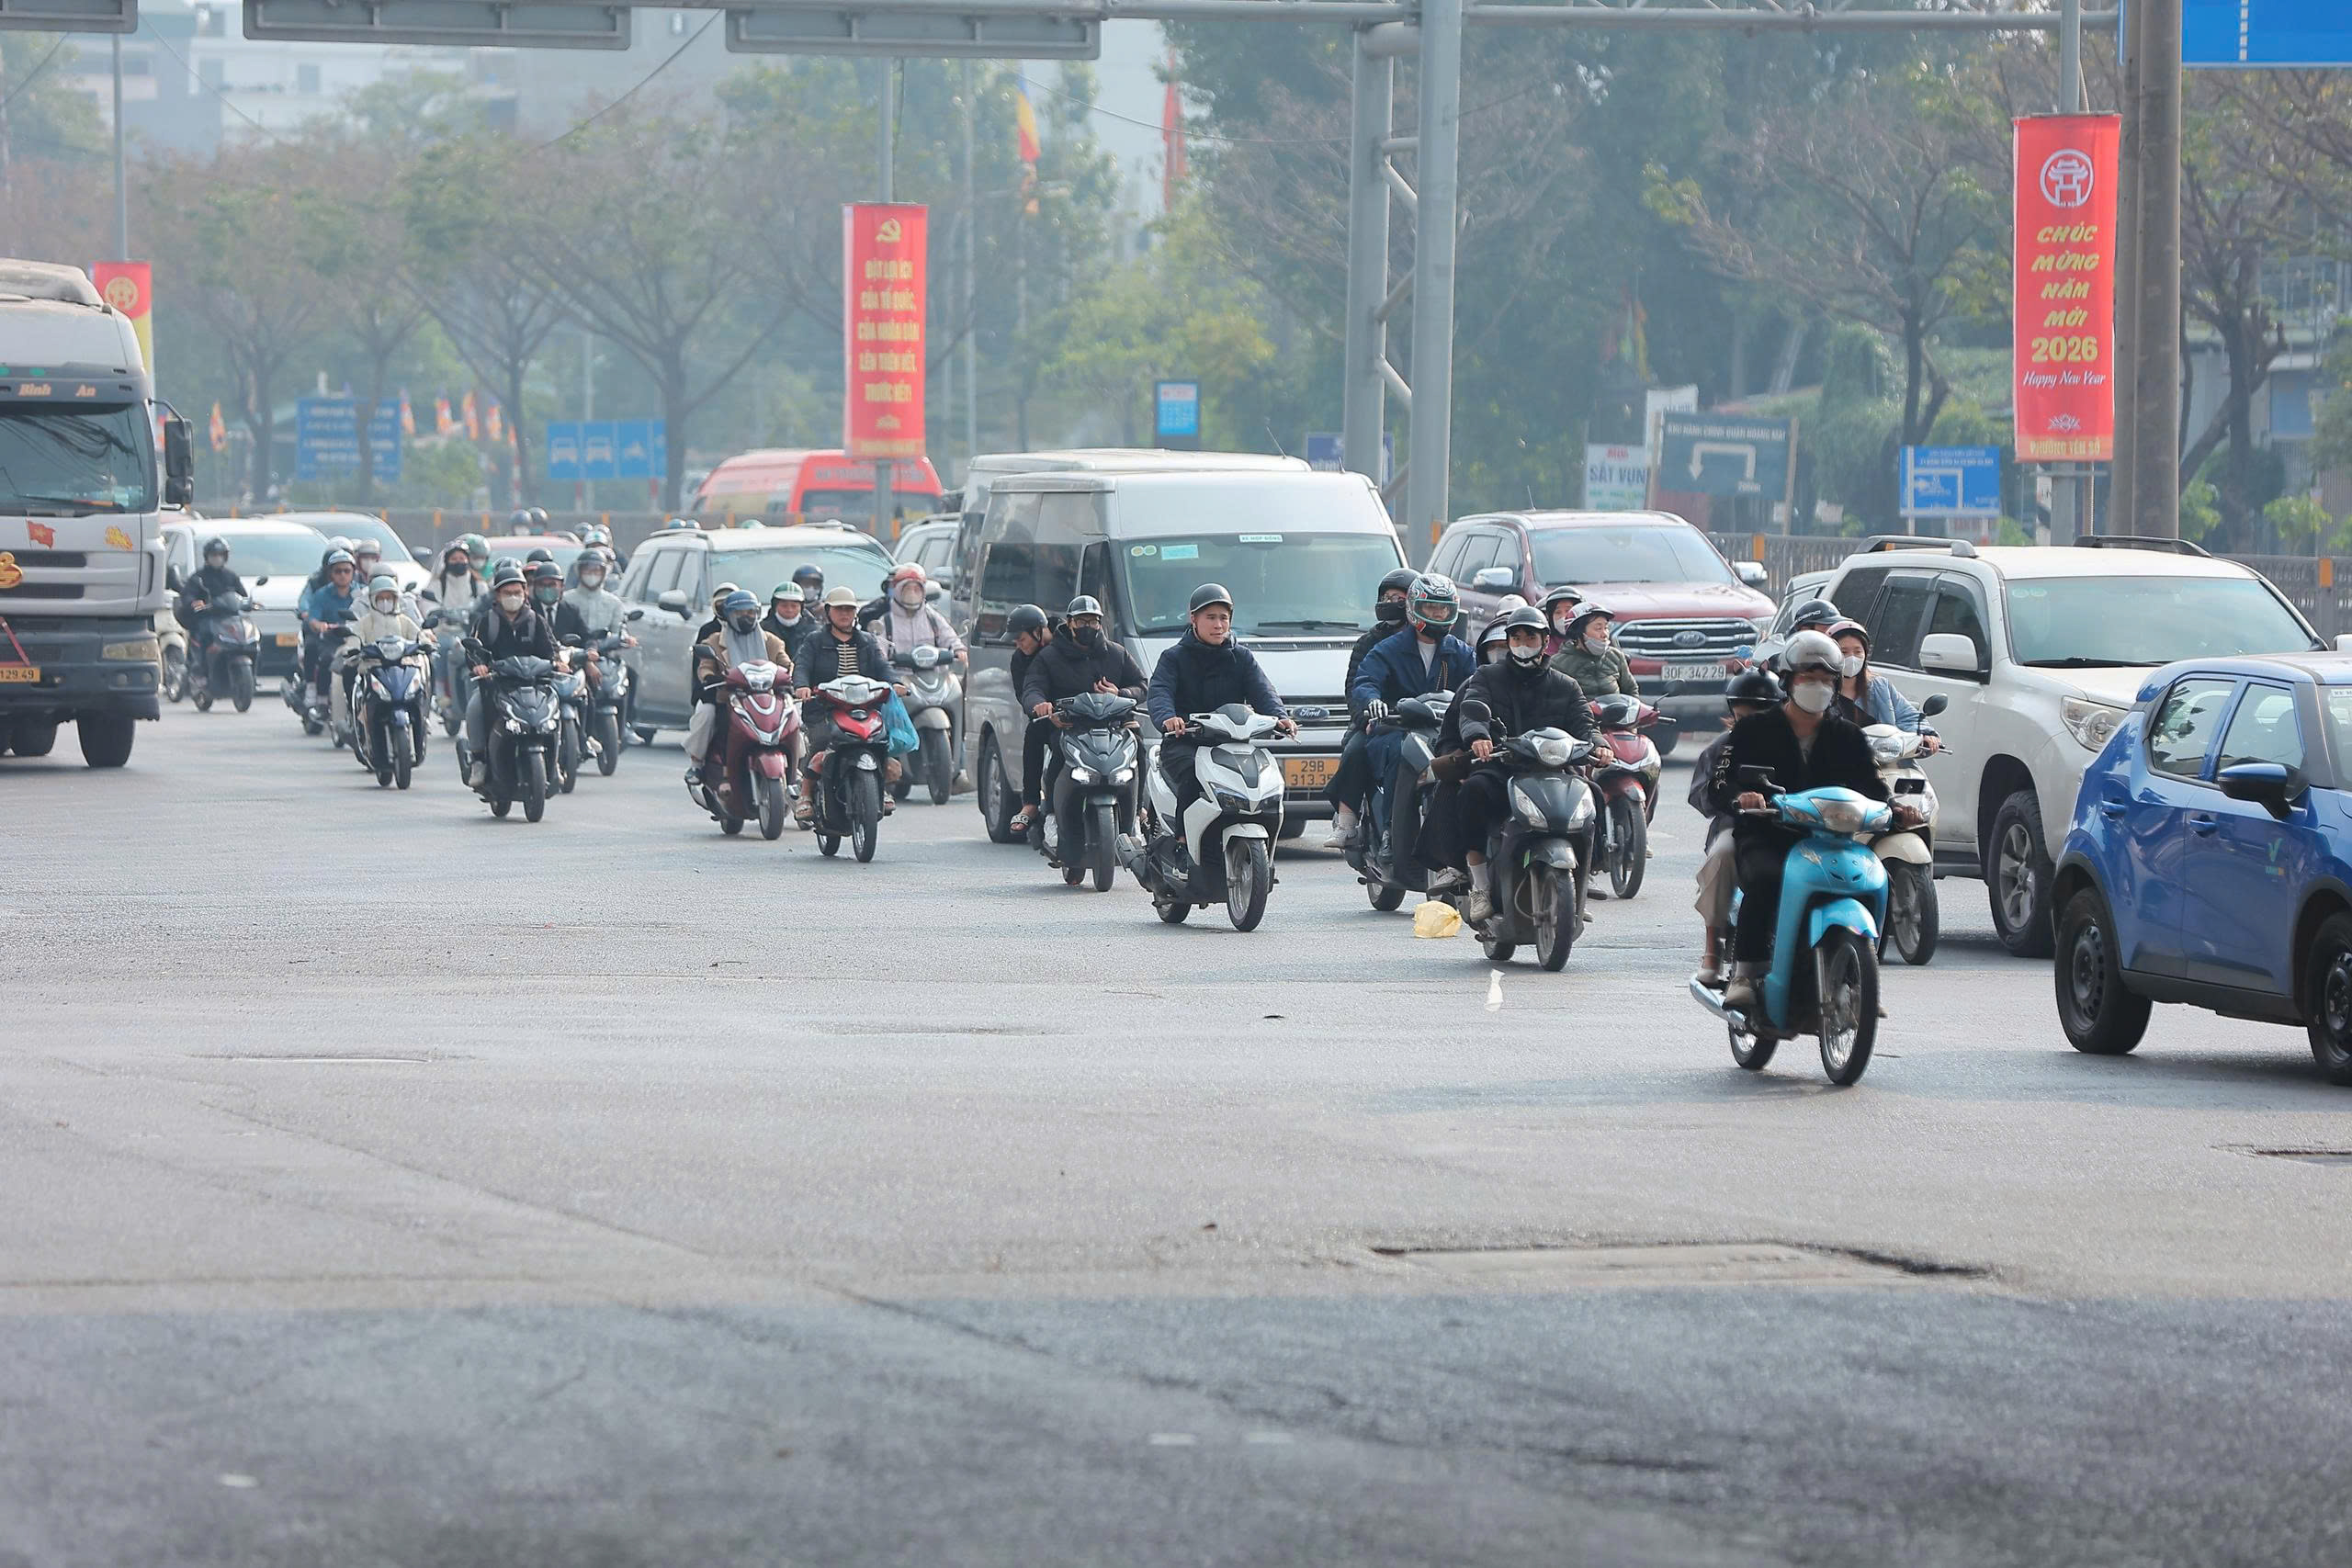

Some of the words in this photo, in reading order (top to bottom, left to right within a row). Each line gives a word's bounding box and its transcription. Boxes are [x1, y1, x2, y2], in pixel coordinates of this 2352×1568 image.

[2037, 221, 2098, 243] CHÚC
[2031, 250, 2099, 272] MỪNG
[2041, 277, 2090, 299] NĂM
[2043, 306, 2087, 327] MỚI
[2031, 336, 2098, 363] 2026
[2023, 370, 2057, 389] Happy
[2059, 370, 2081, 385] New
[2083, 370, 2106, 385] Year
[1299, 707, 1321, 717] Ford
[1301, 761, 1325, 773] 29B
